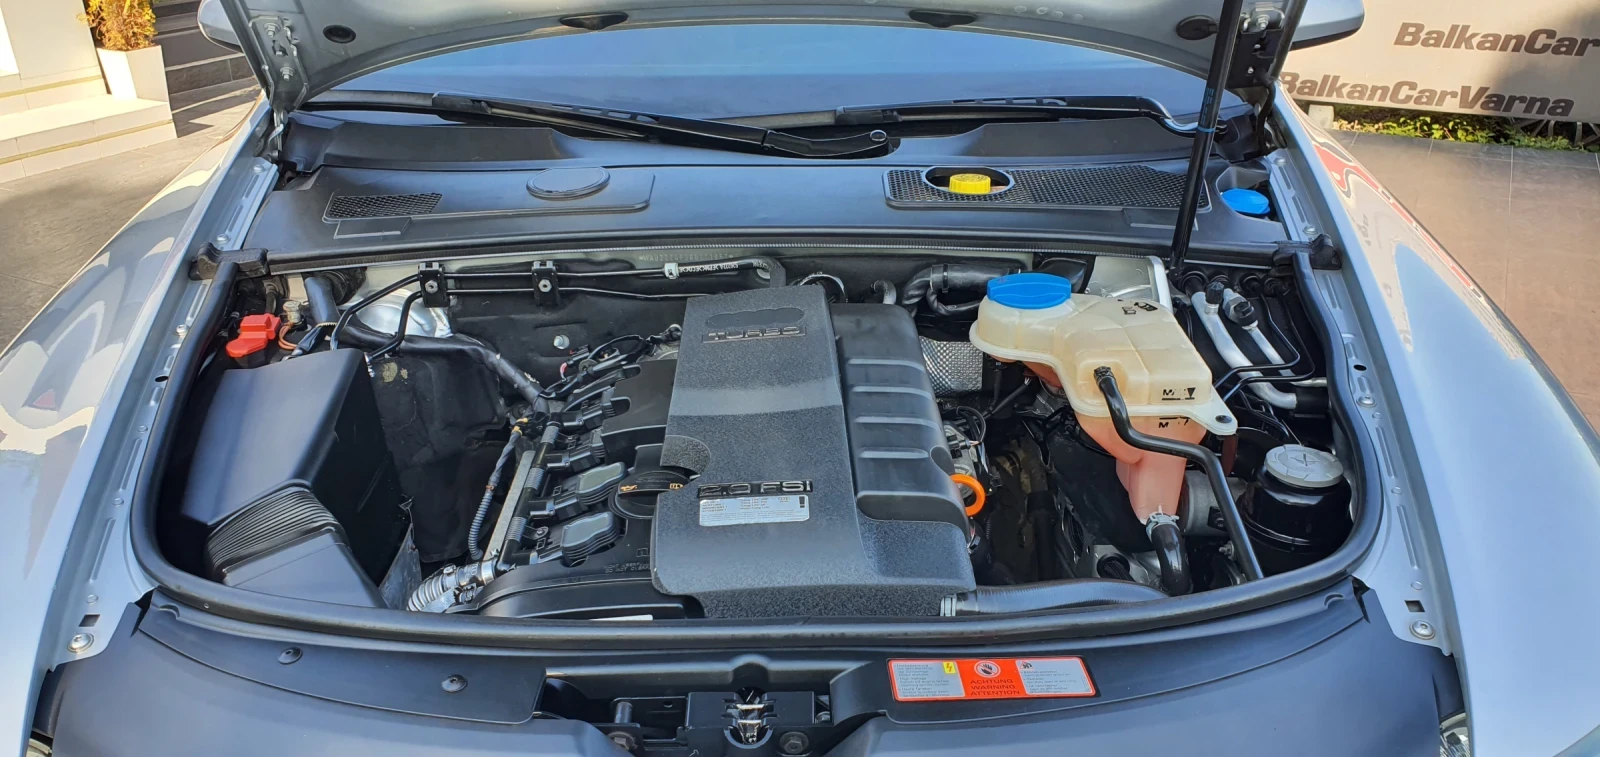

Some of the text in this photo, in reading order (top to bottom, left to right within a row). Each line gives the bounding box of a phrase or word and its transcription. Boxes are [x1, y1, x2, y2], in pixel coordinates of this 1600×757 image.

[1393, 22, 1600, 57] BalkanCar
[1280, 71, 1575, 117] BalkanCarVarna
[708, 326, 800, 341] TURBO
[700, 483, 751, 496] 2.0
